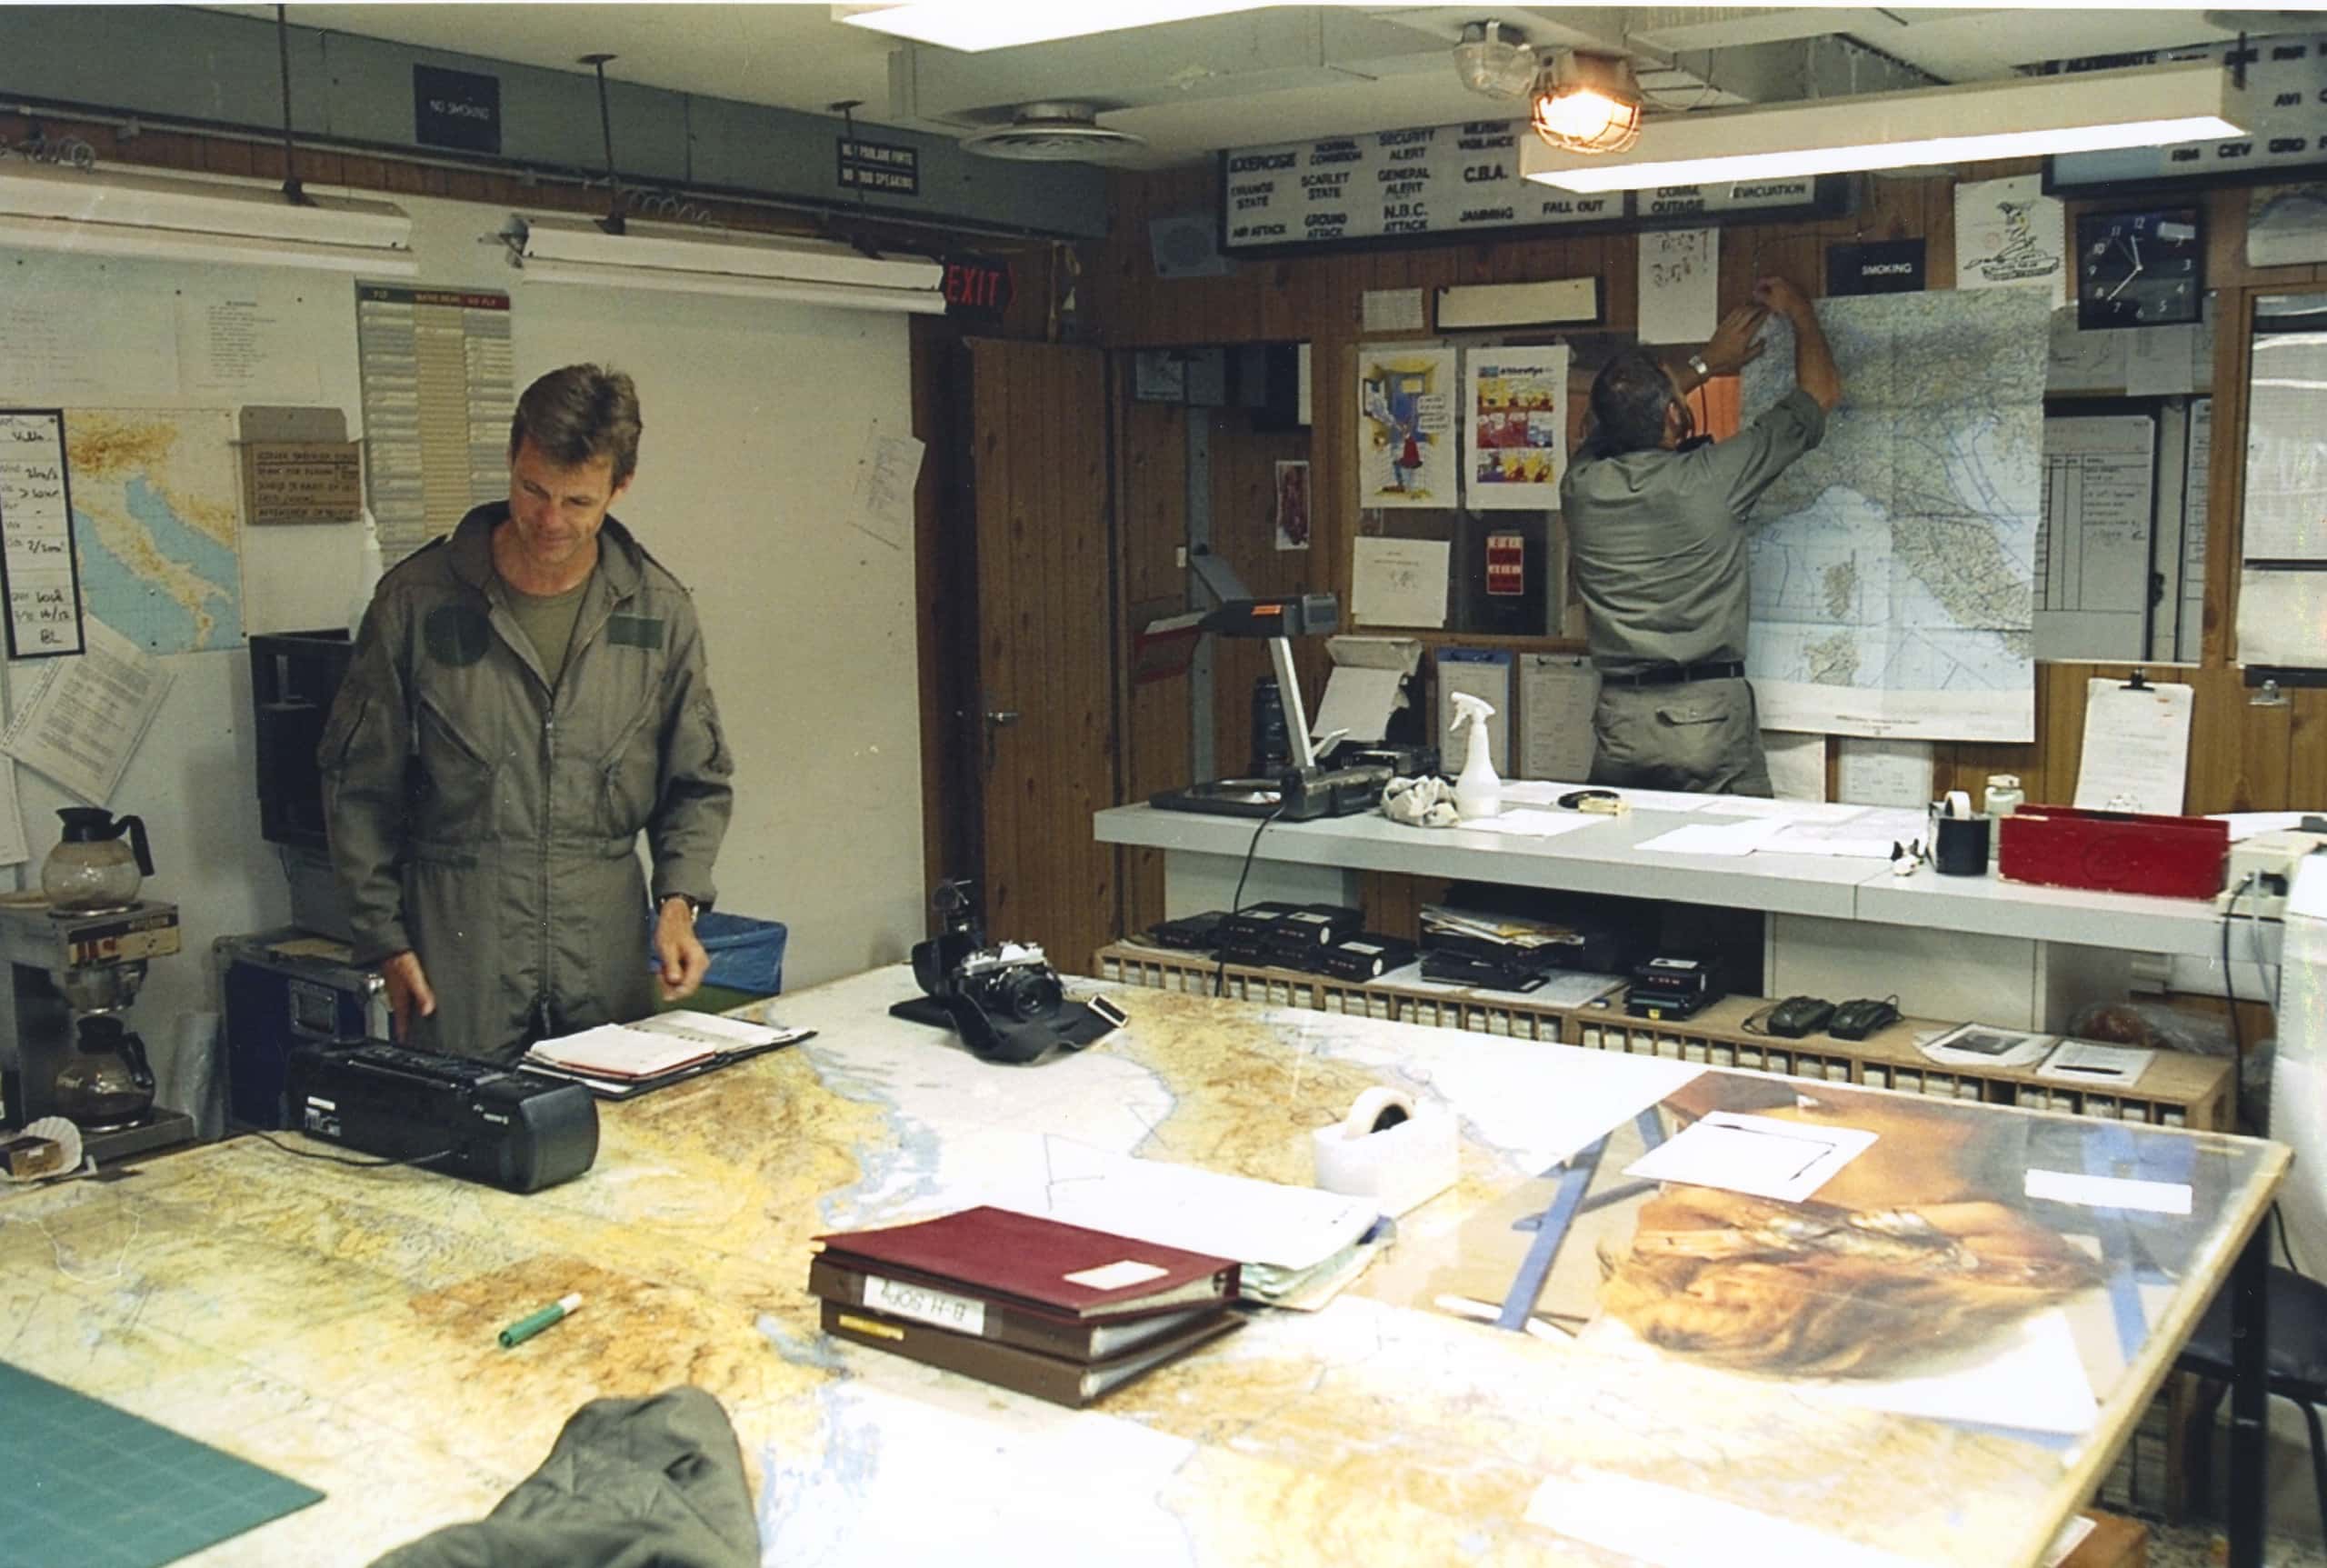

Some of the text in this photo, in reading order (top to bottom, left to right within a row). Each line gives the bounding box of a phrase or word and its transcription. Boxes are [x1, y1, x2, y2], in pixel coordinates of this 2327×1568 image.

[429, 100, 490, 121] NO SMOKING
[1379, 130, 1435, 146] SECURITY
[1389, 147, 1426, 161] ALERT
[1229, 153, 1297, 174] EXERCISE
[1301, 173, 1351, 187] SCARLET
[1378, 168, 1431, 182] GENERAL
[1463, 164, 1509, 183] C.B.A.
[1308, 187, 1341, 201] STATE
[1385, 182, 1423, 195] ALERT
[1733, 184, 1806, 198] EVACUATION
[1236, 195, 1269, 210] STATE
[1543, 200, 1604, 215] FALL OUT
[1651, 198, 1705, 212] OUTAGE
[1383, 203, 1428, 219] N.B.C.
[1459, 207, 1514, 223] JAMMING
[1304, 213, 1347, 227] GROUND
[1383, 219, 1428, 233] ATTACK
[2133, 216, 2146, 229] 12
[1251, 224, 1287, 237] ATTACK
[1306, 227, 1343, 239] ATTACK
[1862, 263, 1913, 275] SMOKING
[2182, 258, 2192, 271] 3
[946, 263, 999, 306] EXIT
[2159, 299, 2168, 313] 5
